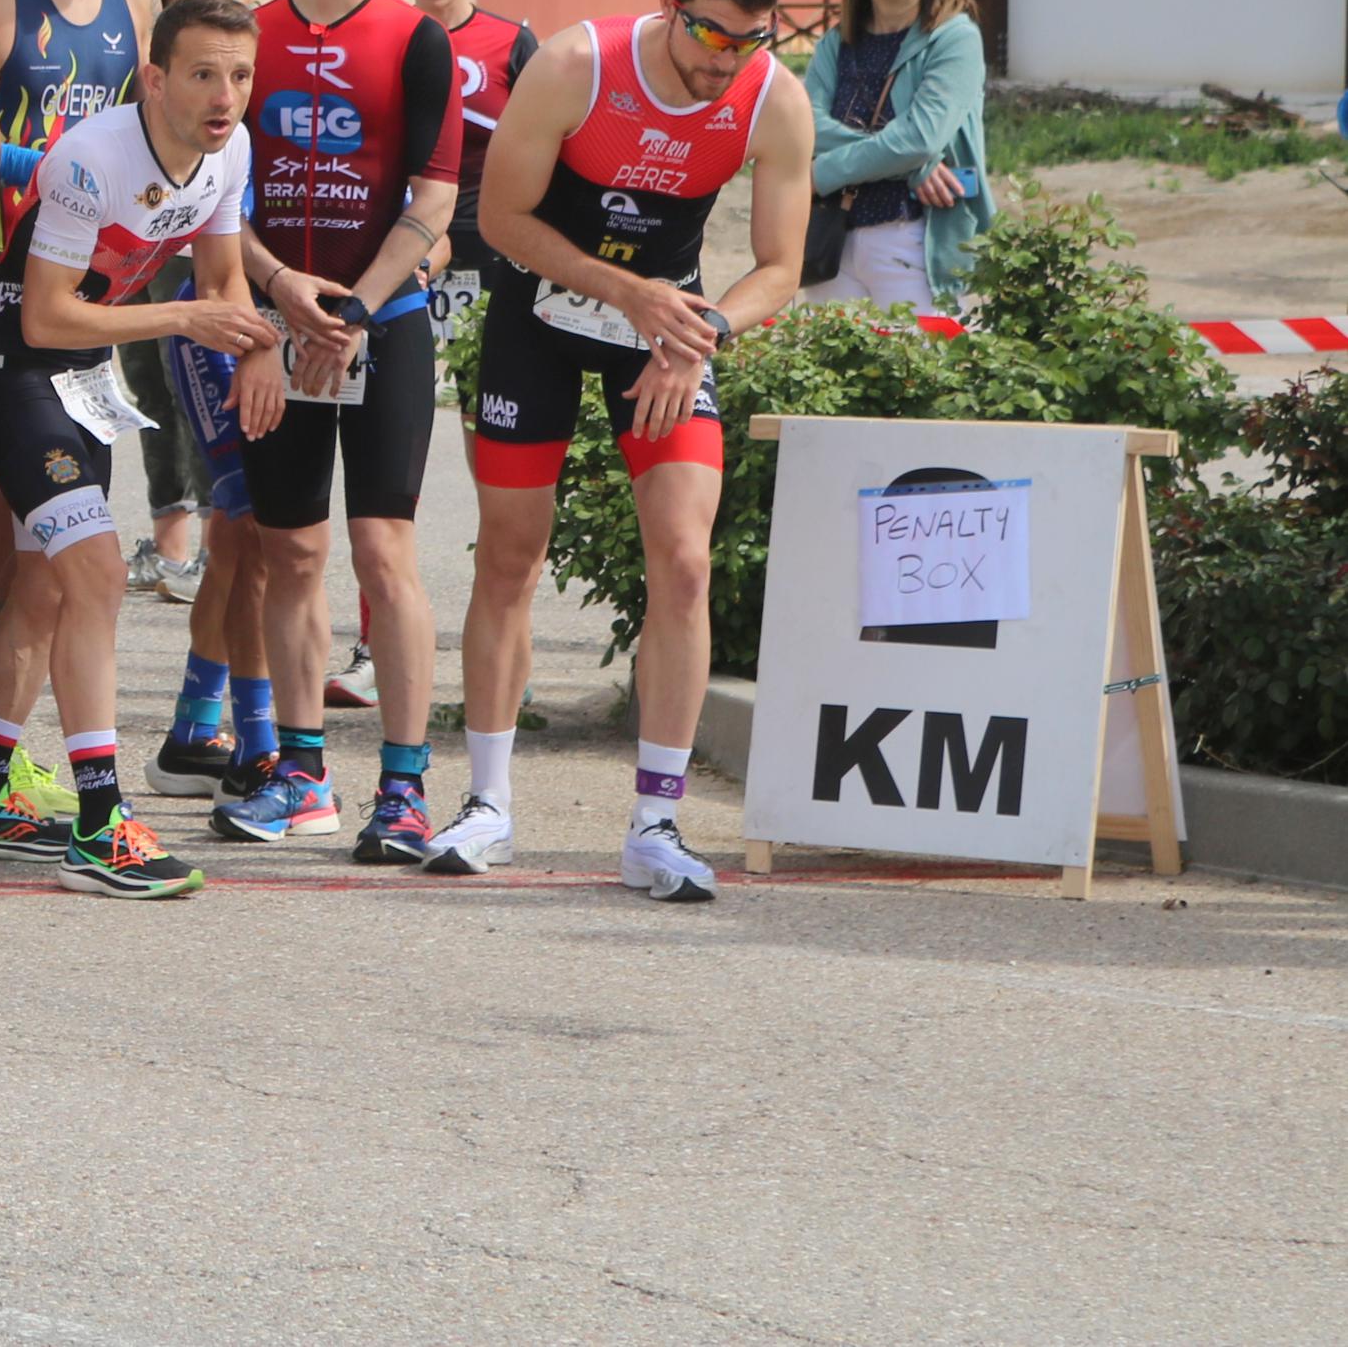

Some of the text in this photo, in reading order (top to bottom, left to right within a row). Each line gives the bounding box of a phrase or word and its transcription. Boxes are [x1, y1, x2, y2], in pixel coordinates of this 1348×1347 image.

[40, 84, 116, 116] GUERRA
[280, 106, 361, 138] ISG
[611, 161, 688, 196] PÉREZ
[609, 212, 662, 227] Diputación
[618, 221, 647, 233] Soria
[482, 392, 519, 417] MAD
[874, 503, 1010, 545] PENALTY
[896, 553, 986, 595] BOX
[811, 703, 1029, 817] KM
